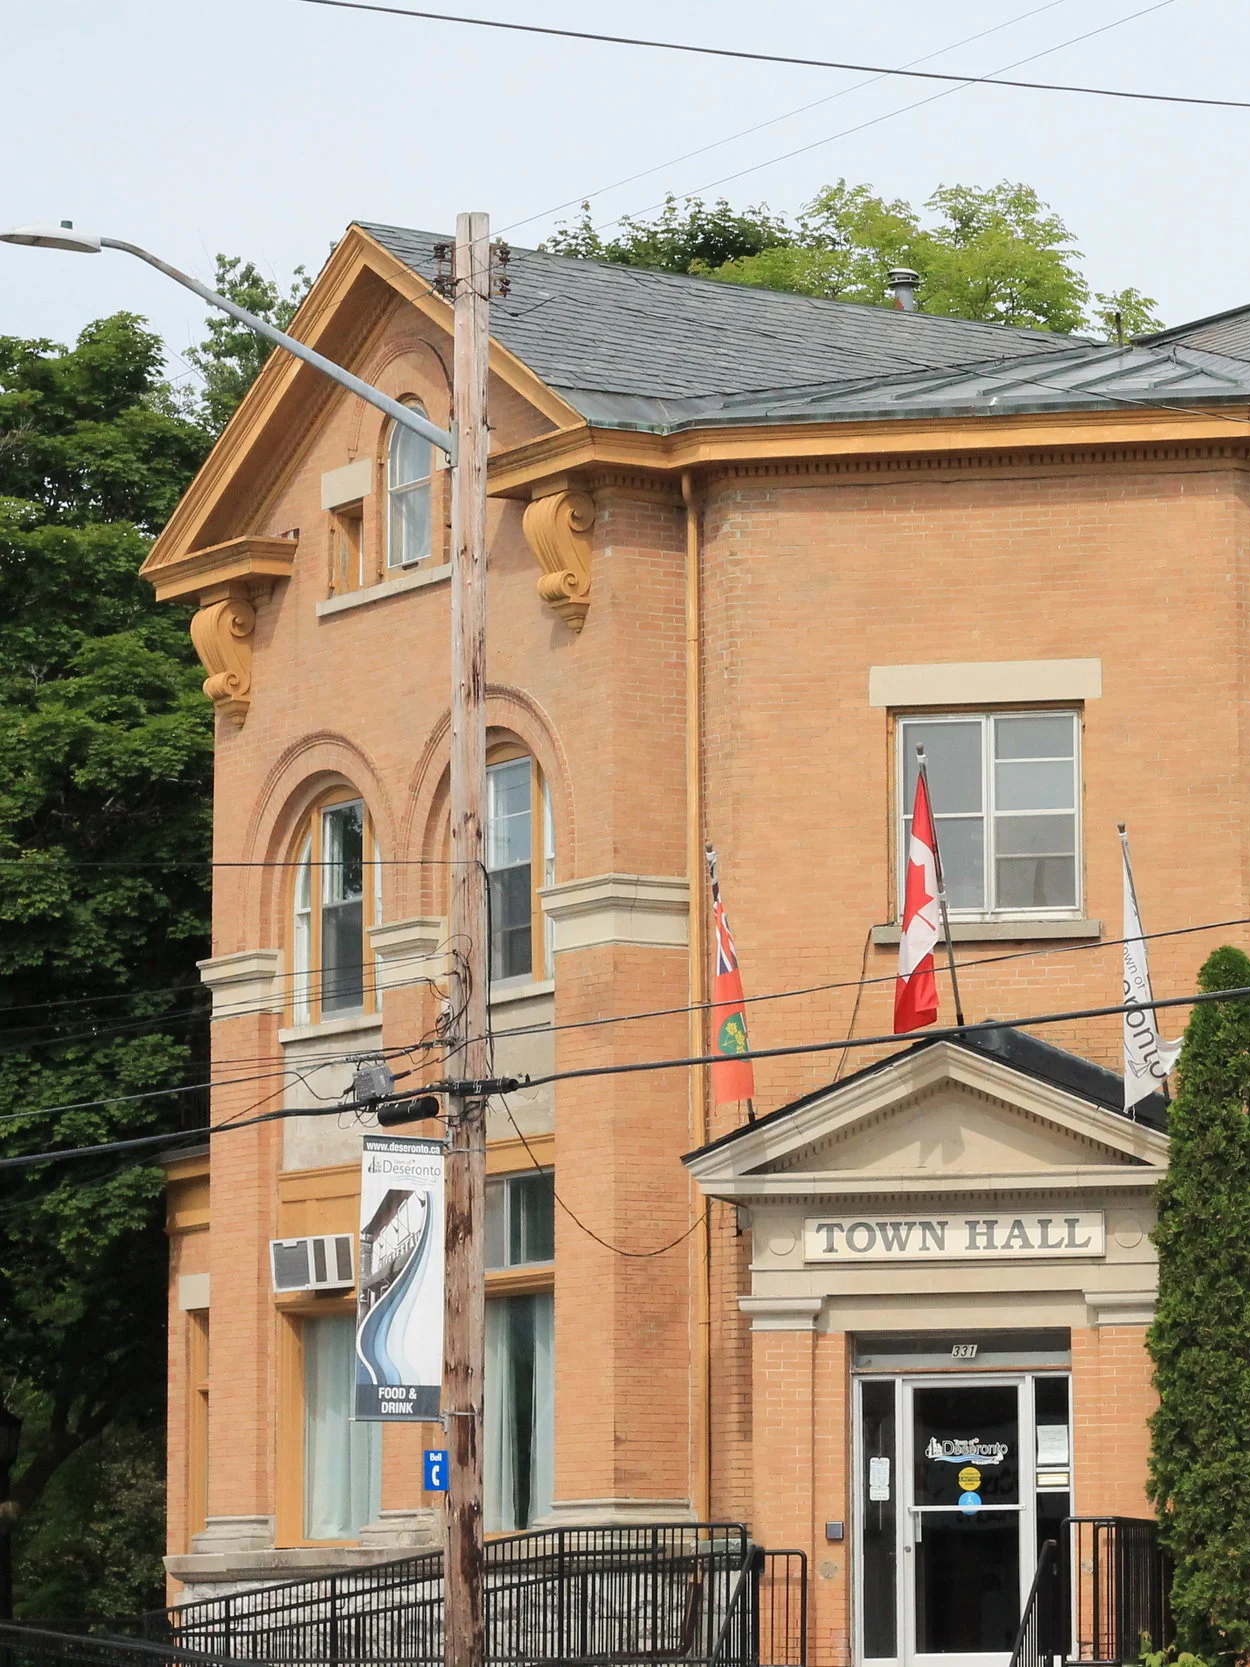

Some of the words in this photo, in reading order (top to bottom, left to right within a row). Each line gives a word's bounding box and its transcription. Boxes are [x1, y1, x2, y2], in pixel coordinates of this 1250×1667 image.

[366, 1141, 441, 1154] www.deseronto.ca
[382, 1159, 442, 1177] Deseronto
[816, 1220, 949, 1253] TOWN
[965, 1218, 1092, 1250] HALL
[952, 1345, 975, 1357] 331
[378, 1387, 406, 1399] FOOD
[408, 1387, 417, 1400] &
[381, 1402, 413, 1414] DRINK
[942, 1440, 1009, 1456] Deseronto
[429, 1452, 442, 1461] Bell
